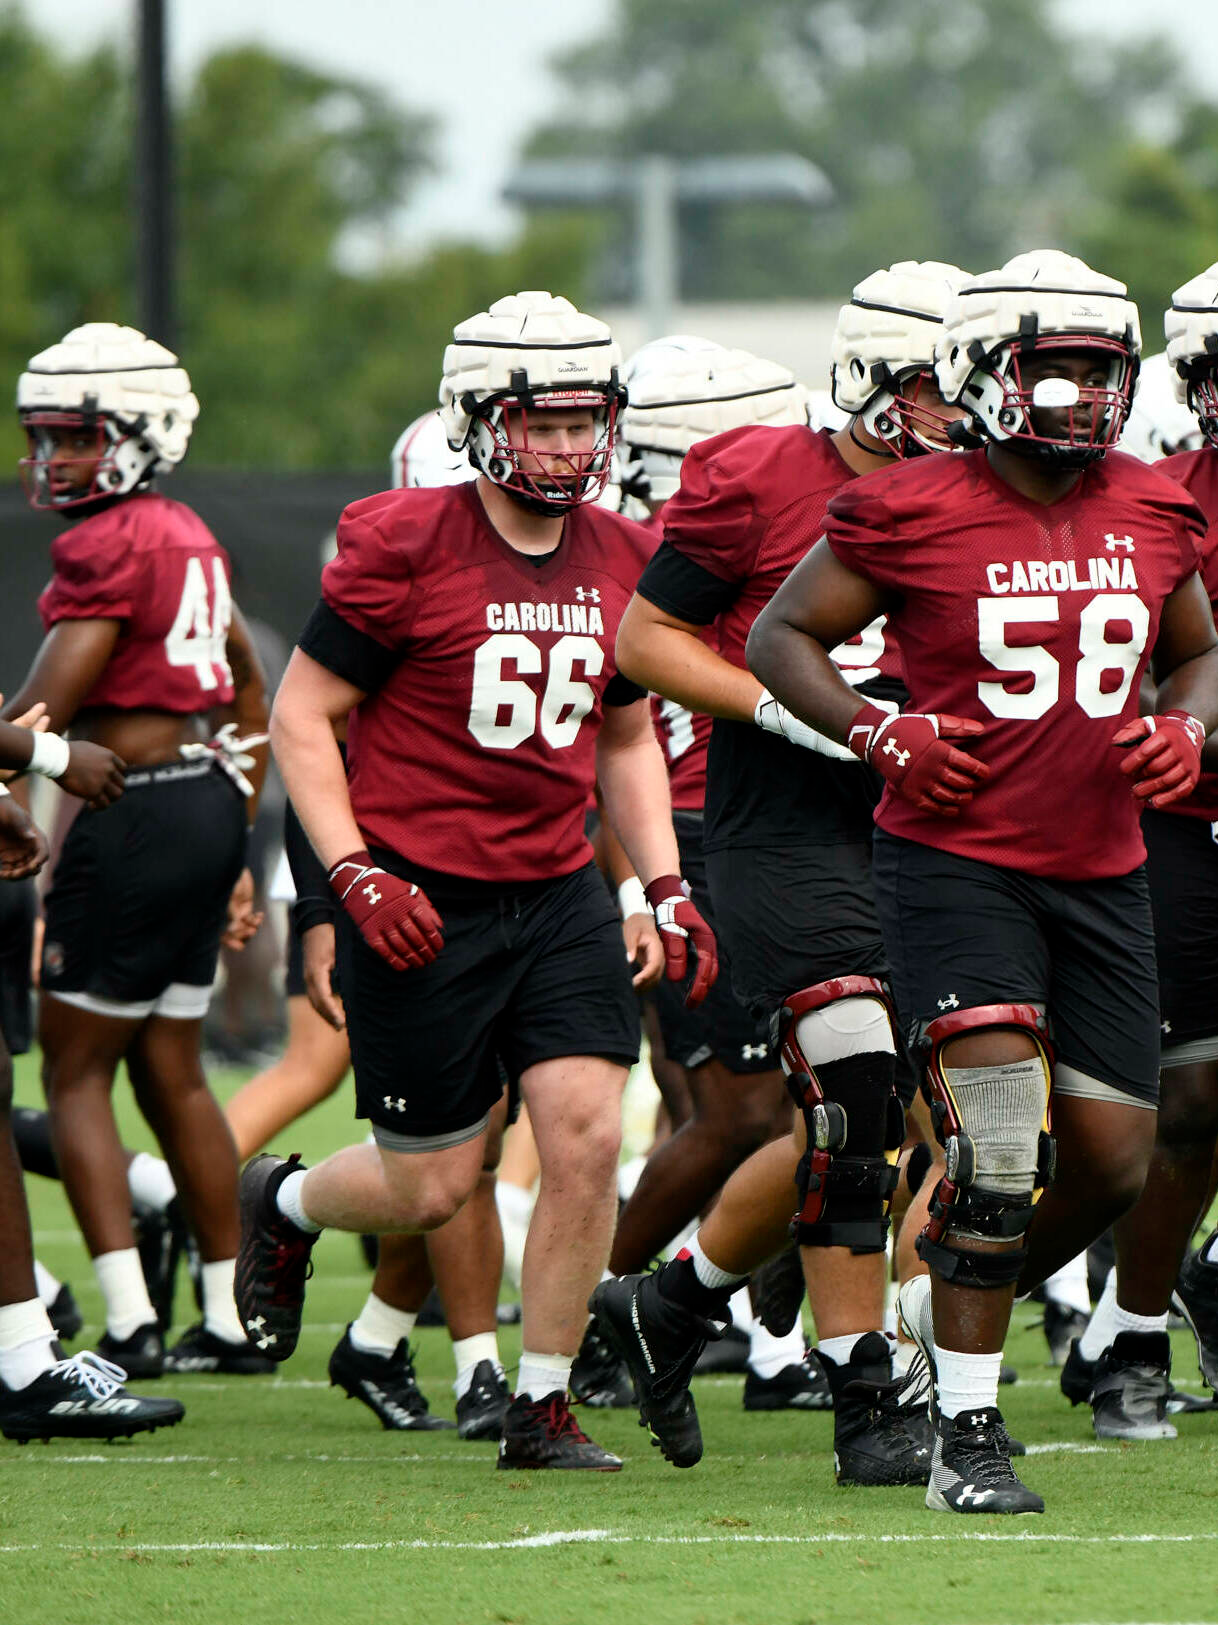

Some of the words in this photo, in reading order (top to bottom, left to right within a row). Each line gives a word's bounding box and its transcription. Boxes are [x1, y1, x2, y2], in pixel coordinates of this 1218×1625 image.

[986, 557, 1139, 594] CAROLINA
[486, 602, 605, 636] CAROLINA
[977, 593, 1151, 720] 58
[467, 633, 605, 750] 66
[631, 1294, 641, 1331] UNDER
[637, 1331, 656, 1375] ARMOUR
